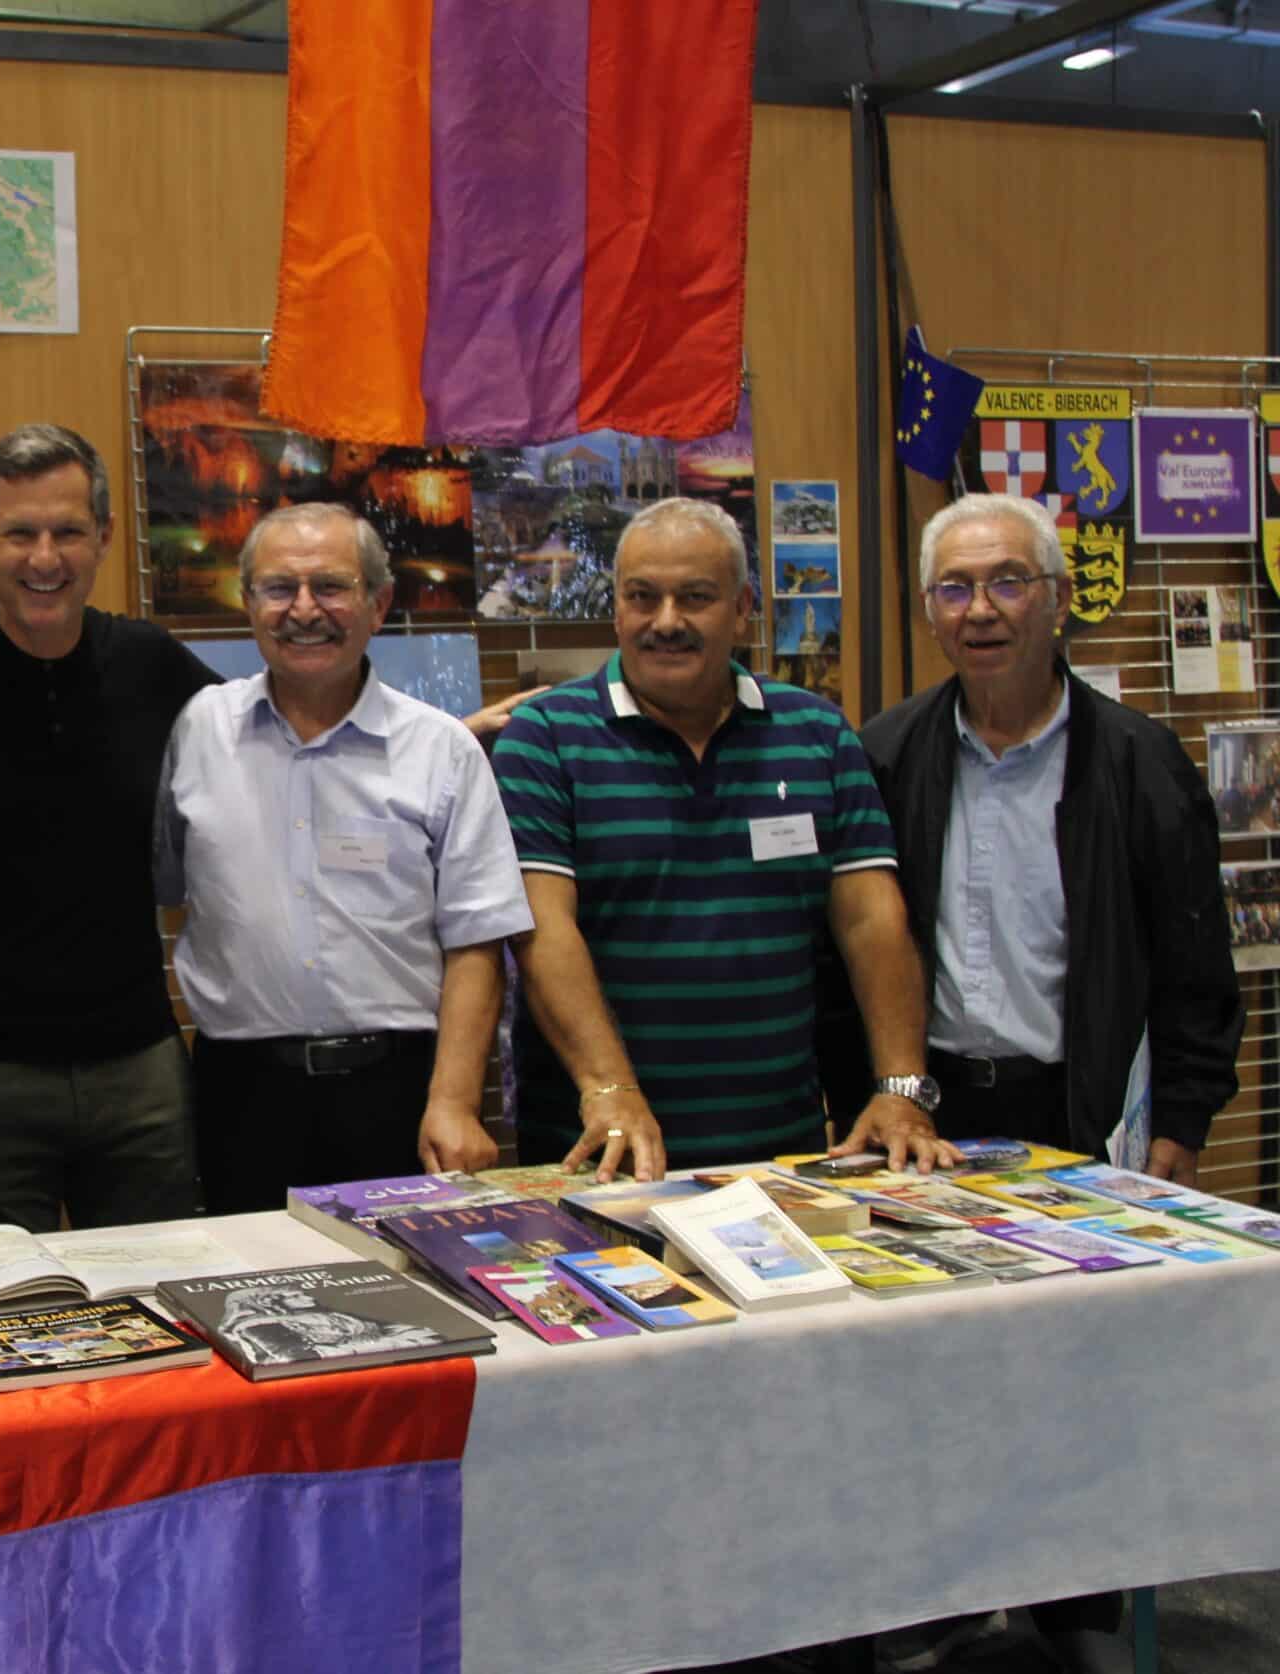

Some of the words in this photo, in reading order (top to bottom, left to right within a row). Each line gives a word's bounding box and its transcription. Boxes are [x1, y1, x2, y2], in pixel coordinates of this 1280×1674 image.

[985, 391, 1045, 411] VALENCE
[1055, 392, 1119, 412] BIBERACH
[400, 1200, 551, 1231] LIBAN
[301, 1272, 392, 1290] d'Antan
